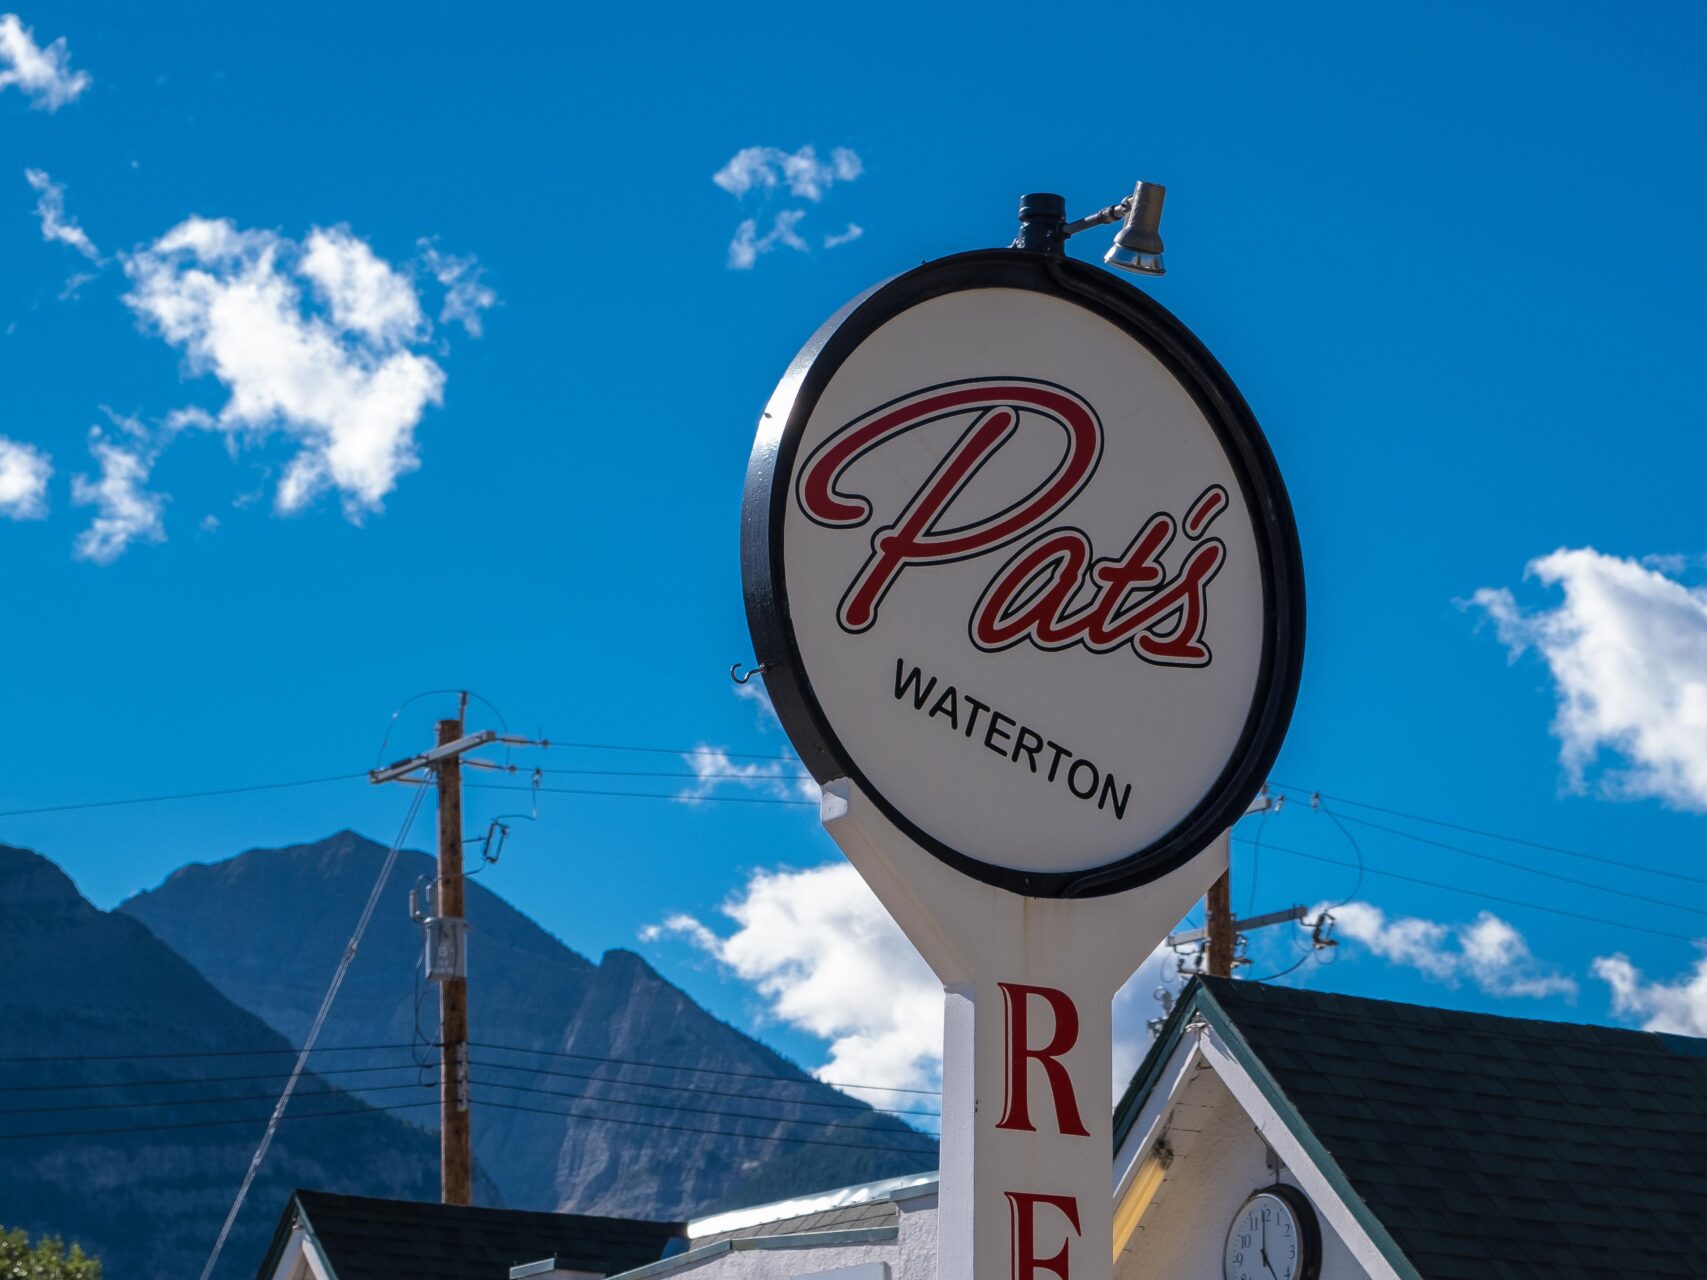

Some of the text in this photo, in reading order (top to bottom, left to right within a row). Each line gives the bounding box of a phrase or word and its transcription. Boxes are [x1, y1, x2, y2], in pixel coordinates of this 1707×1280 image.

[796, 376, 1228, 668] Pat's
[893, 658, 1132, 820] WATERTON
[1284, 1224, 1291, 1238] 2
[1240, 1234, 1251, 1248] 10
[1288, 1245, 1296, 1259] 3
[1236, 1253, 1244, 1267] 9
[1284, 1266, 1291, 1280] 4
